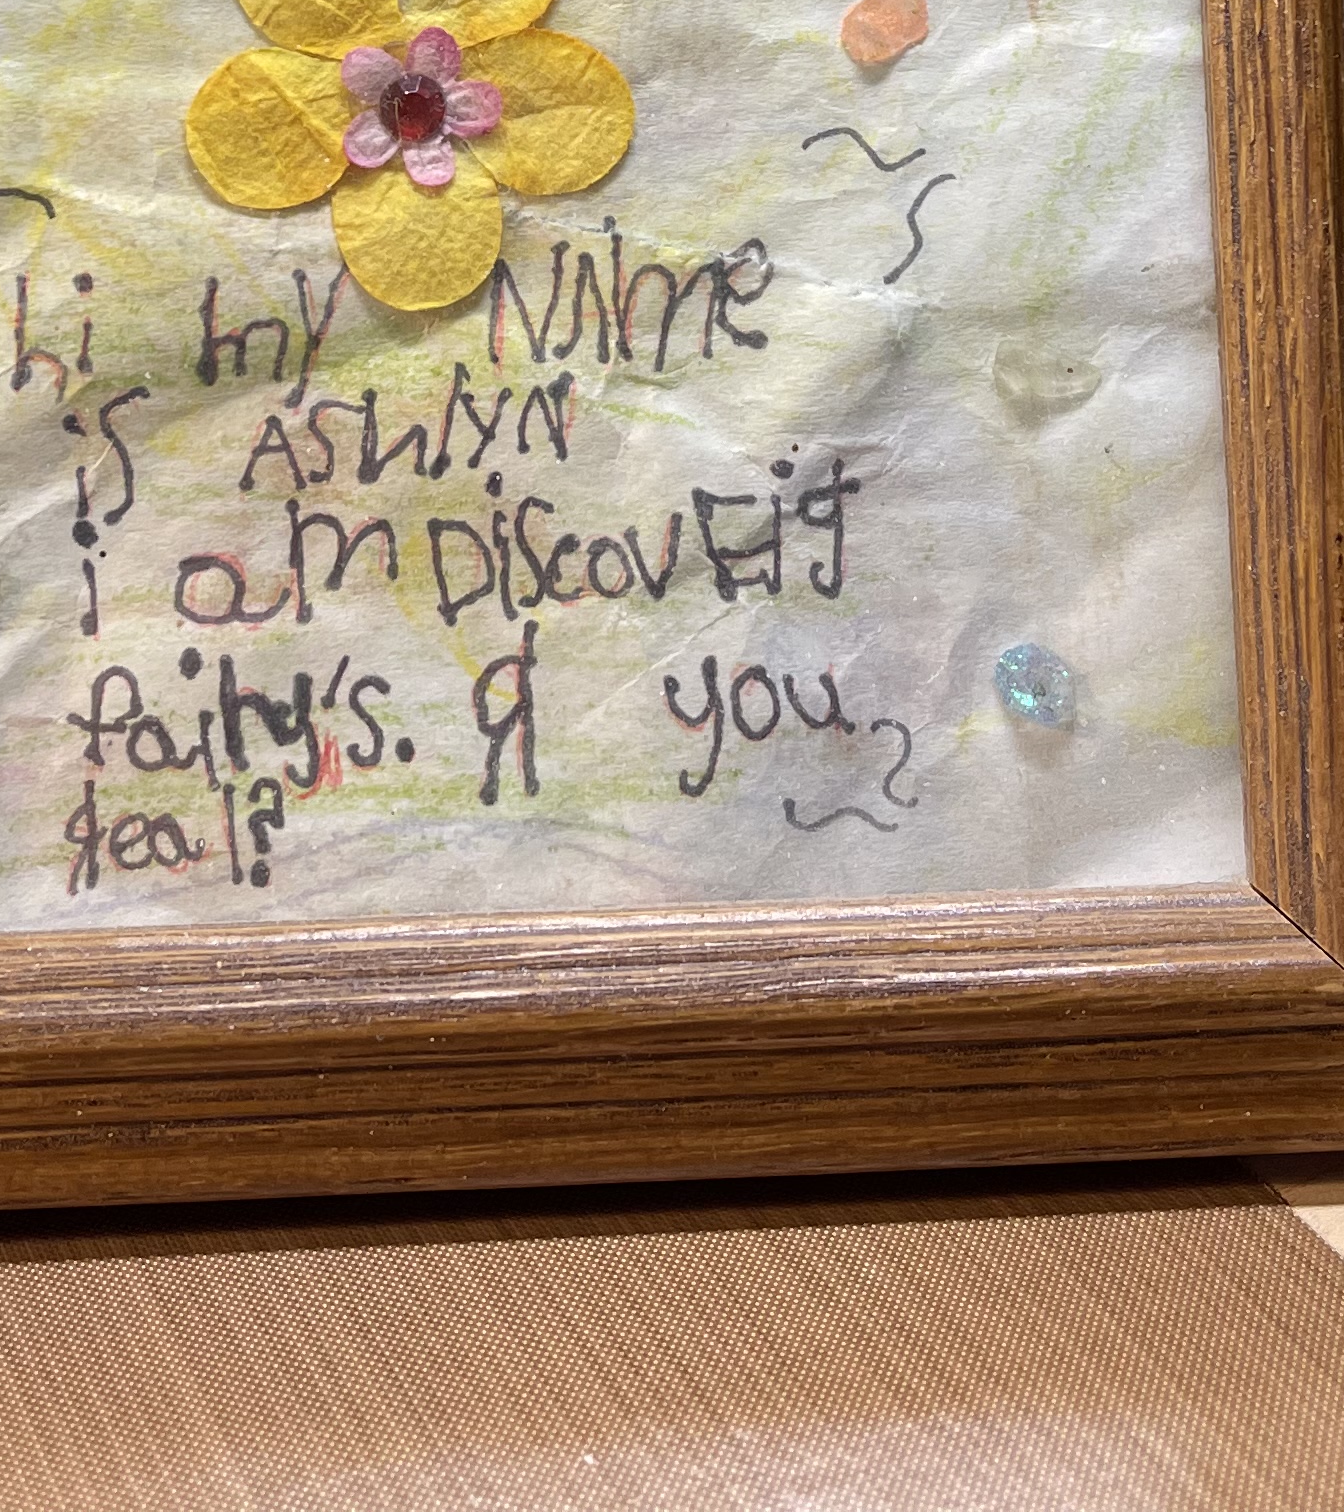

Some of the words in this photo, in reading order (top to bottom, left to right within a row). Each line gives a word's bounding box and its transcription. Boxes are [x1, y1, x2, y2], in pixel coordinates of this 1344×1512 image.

[10, 270, 95, 404] hi
[194, 268, 350, 408] my
[662, 654, 857, 798] you
